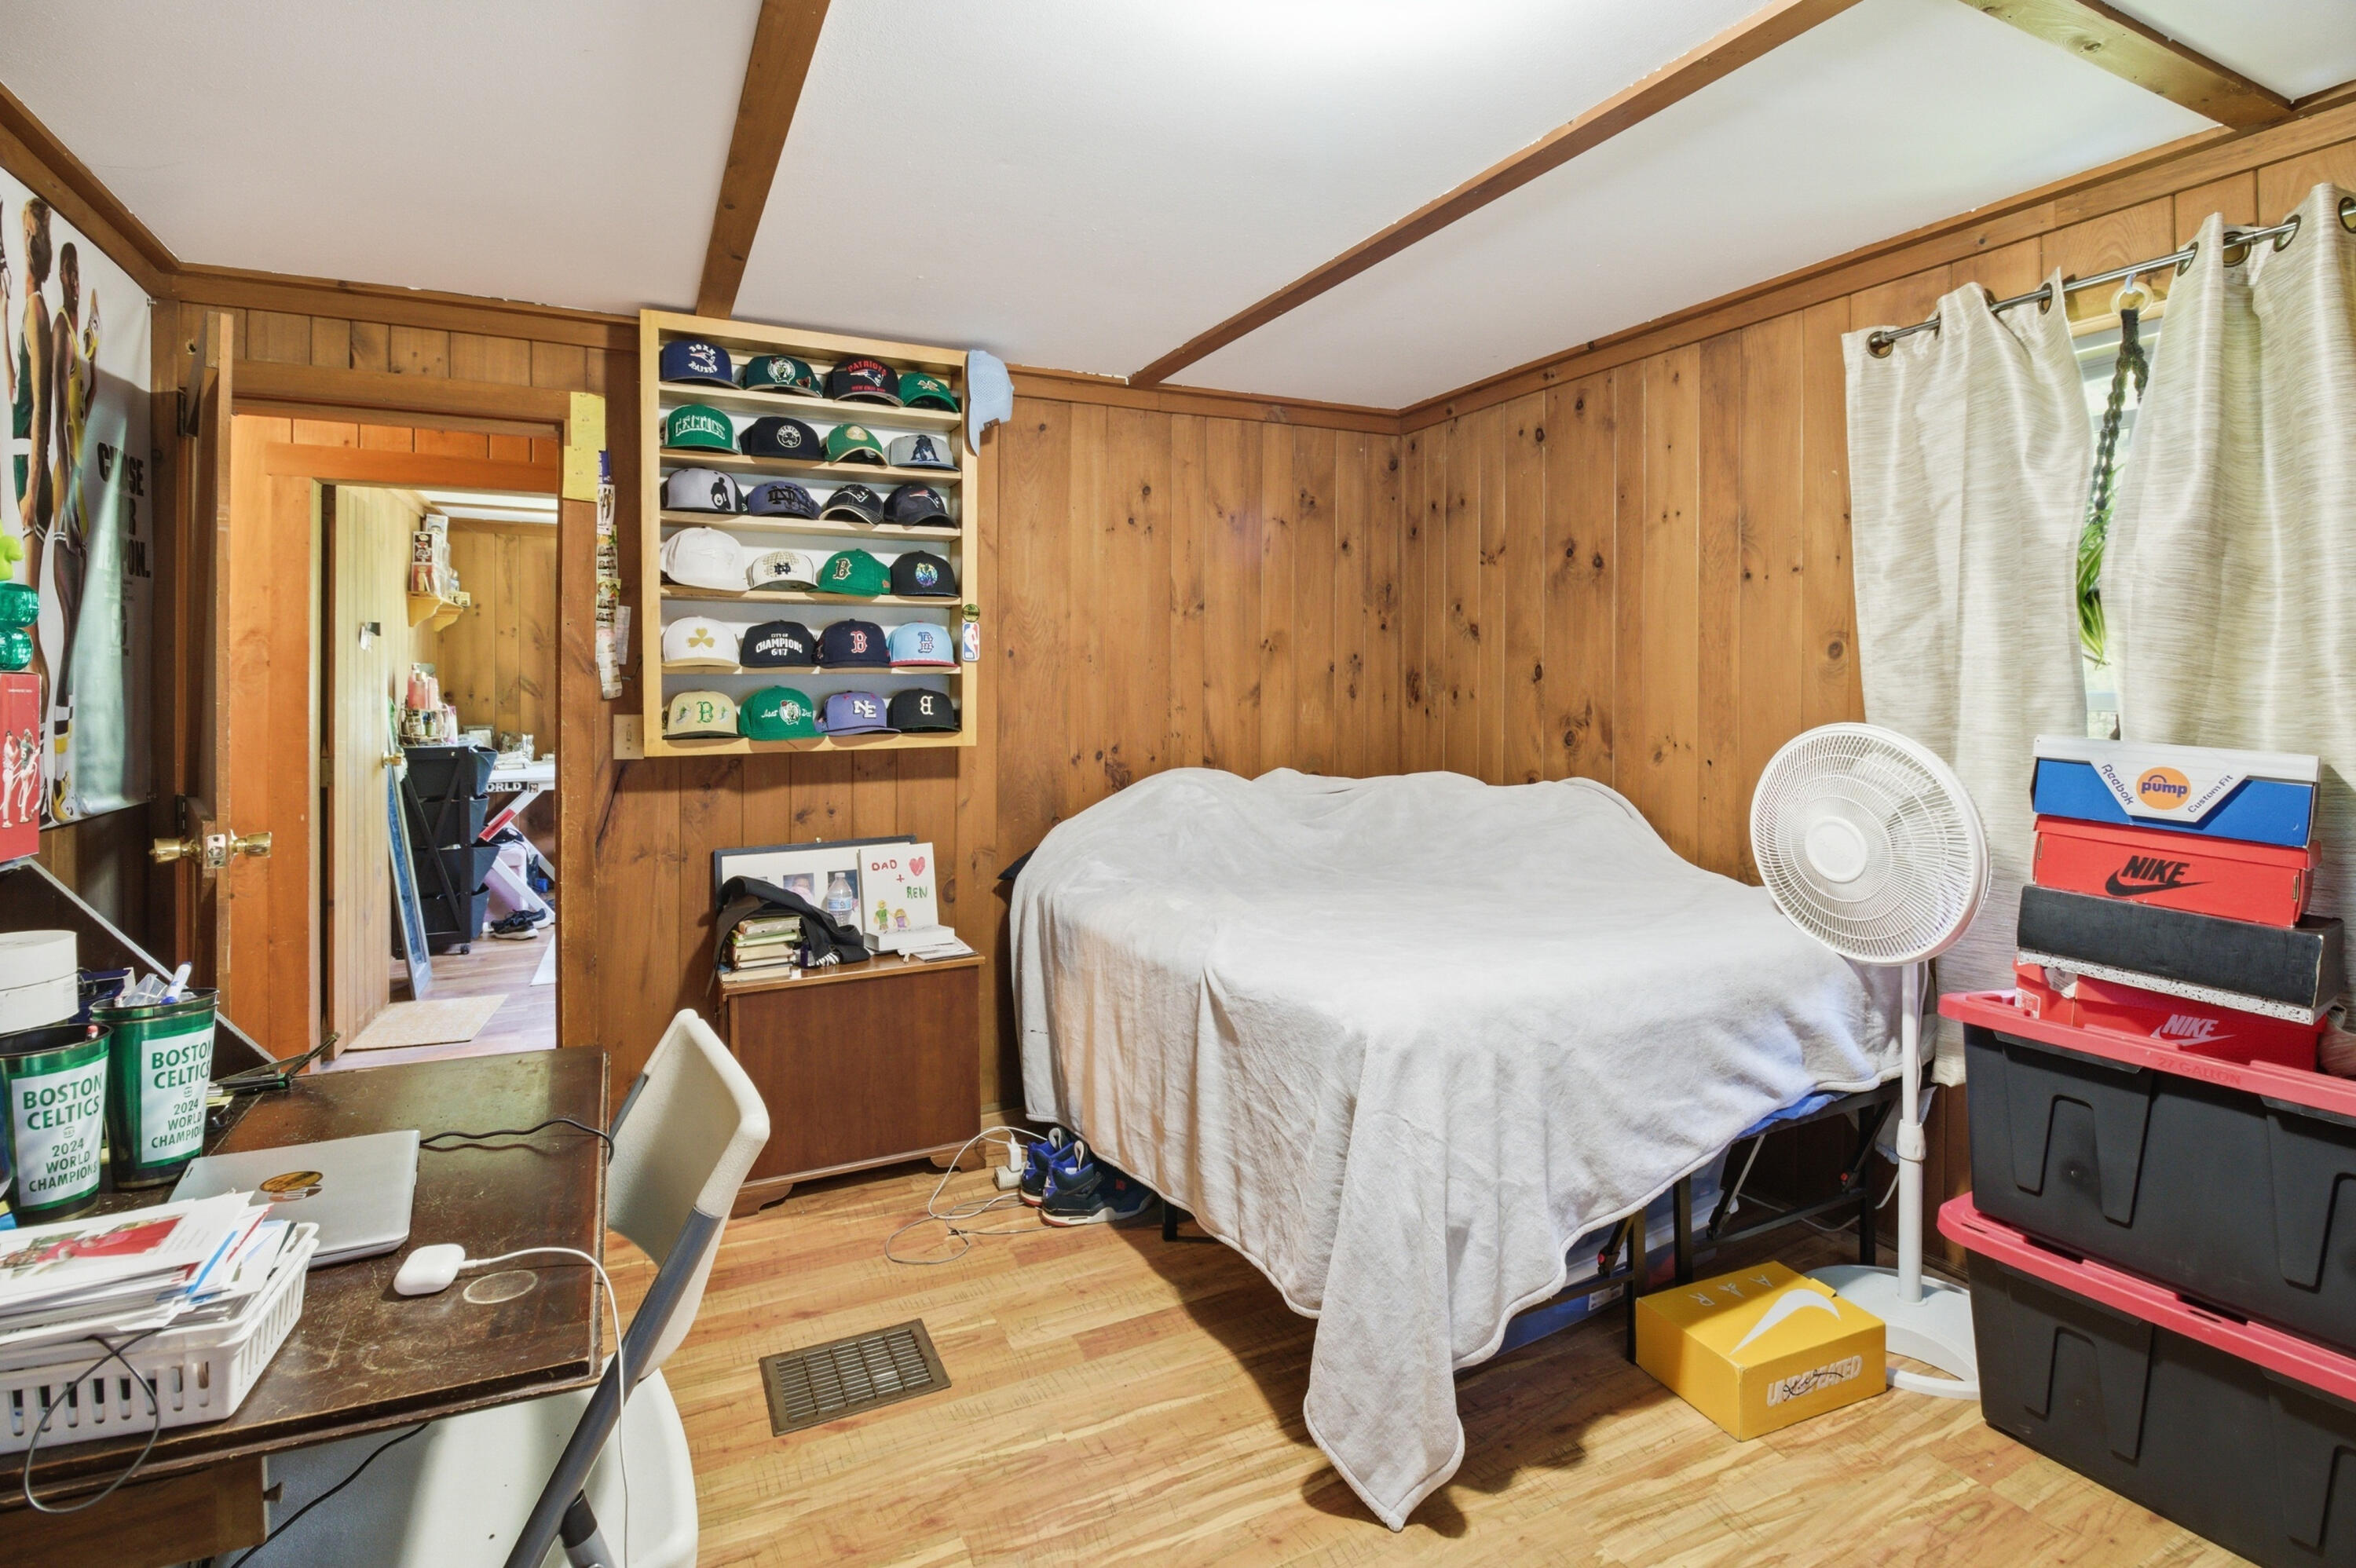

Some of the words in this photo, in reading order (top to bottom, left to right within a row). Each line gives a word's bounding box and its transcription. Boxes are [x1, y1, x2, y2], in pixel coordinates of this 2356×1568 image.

[847, 360, 888, 377] PATRIOTS
[832, 558, 852, 580] B
[755, 638, 803, 654] CHAMPIONS
[850, 630, 868, 654] B
[917, 631, 935, 653] B
[697, 701, 713, 723] B
[853, 700, 876, 718] NE
[920, 695, 934, 715] B
[486, 781, 522, 793] ORLD
[2102, 764, 2134, 805] Reebok
[2141, 781, 2188, 798] pump
[2188, 786, 2221, 813] Custom
[2219, 775, 2233, 787] Fit
[872, 859, 898, 871] DAD
[2121, 855, 2190, 886] NIKE
[906, 886, 928, 899] REN
[2162, 1014, 2219, 1037] NIKE
[152, 1040, 211, 1069] BOSTON
[154, 1060, 210, 1089] CELTICS
[2157, 1056, 2175, 1069] 27
[2179, 1062, 2241, 1086] GALLON
[24, 1073, 102, 1109] BOSTON
[27, 1095, 100, 1131] CELTICS
[174, 1098, 199, 1115] 2024
[167, 1112, 202, 1131] WORLD
[52, 1138, 85, 1157] 2024
[46, 1151, 91, 1174] WORLD
[29, 1161, 98, 1192] CHAMPIONS
